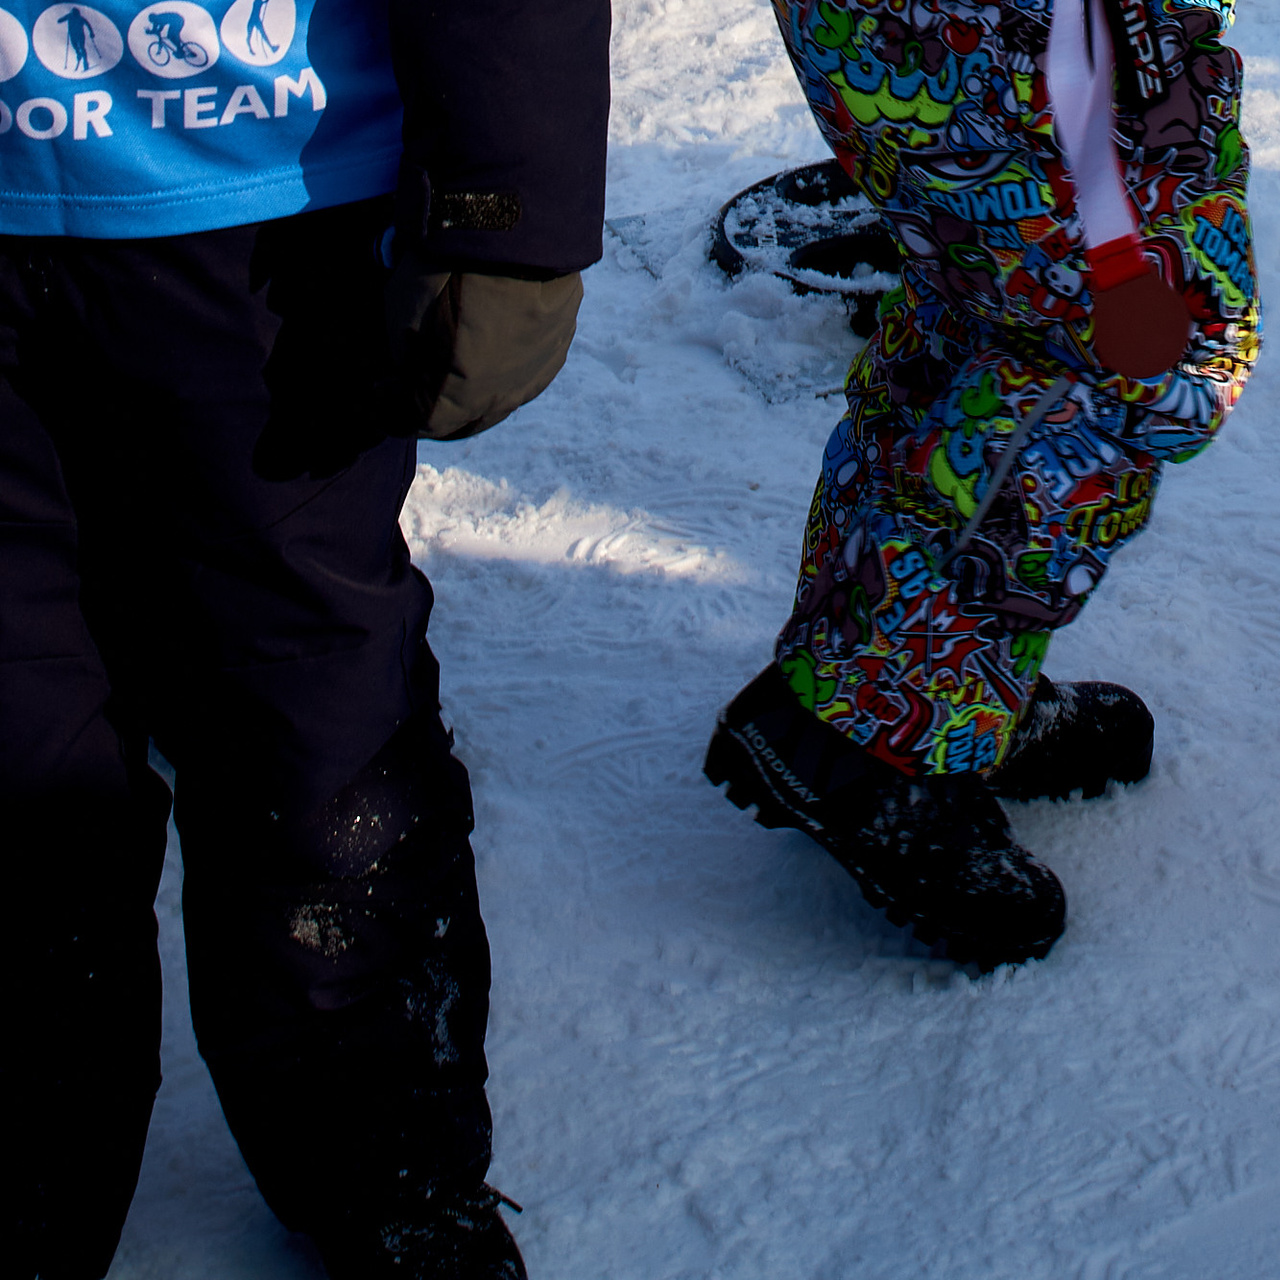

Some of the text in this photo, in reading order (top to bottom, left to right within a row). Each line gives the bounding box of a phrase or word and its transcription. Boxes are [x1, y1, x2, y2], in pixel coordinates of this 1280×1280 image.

[0, 65, 328, 141] OR TEAM
[741, 721, 821, 803] NORDWAY
